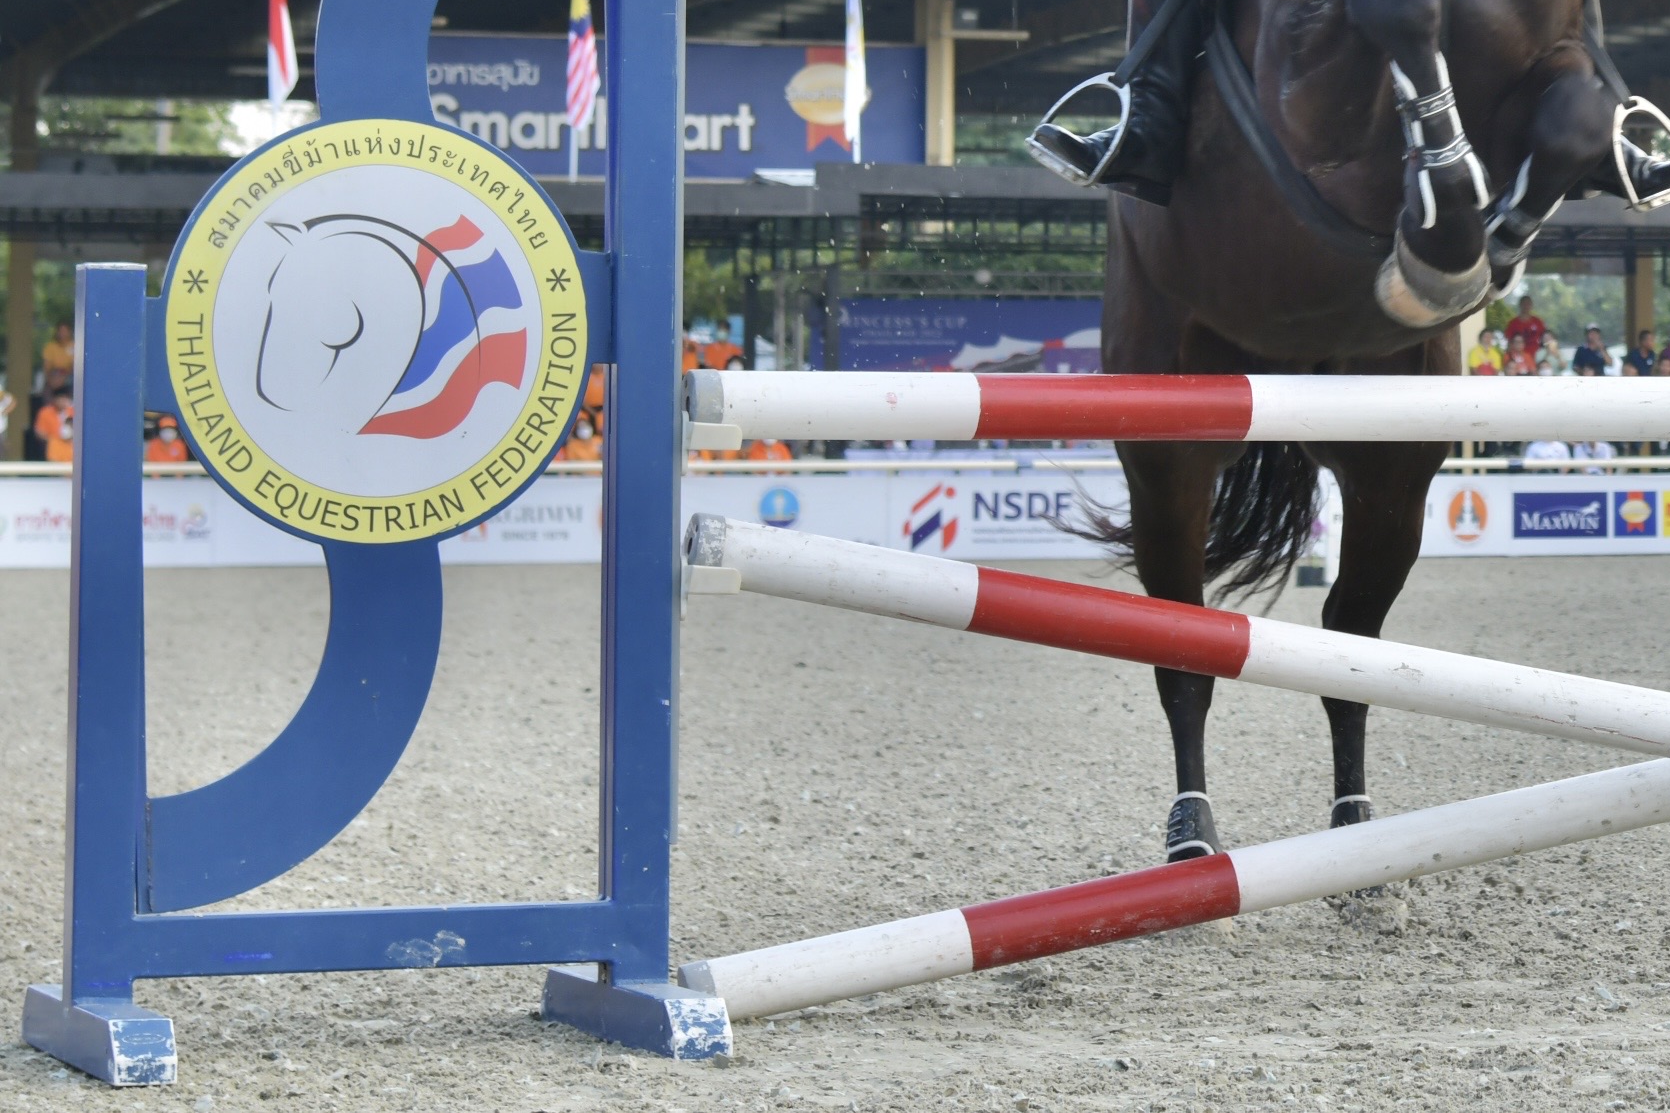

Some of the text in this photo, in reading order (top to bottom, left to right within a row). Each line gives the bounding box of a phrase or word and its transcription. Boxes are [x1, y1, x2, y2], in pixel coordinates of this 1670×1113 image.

[208, 128, 549, 250] สมาคมขี่ม้าแห่งประเทศไทย
[177, 312, 577, 533] THAILAND EQUESTRIAN FEDERATION
[973, 492, 1073, 520] NSDF
